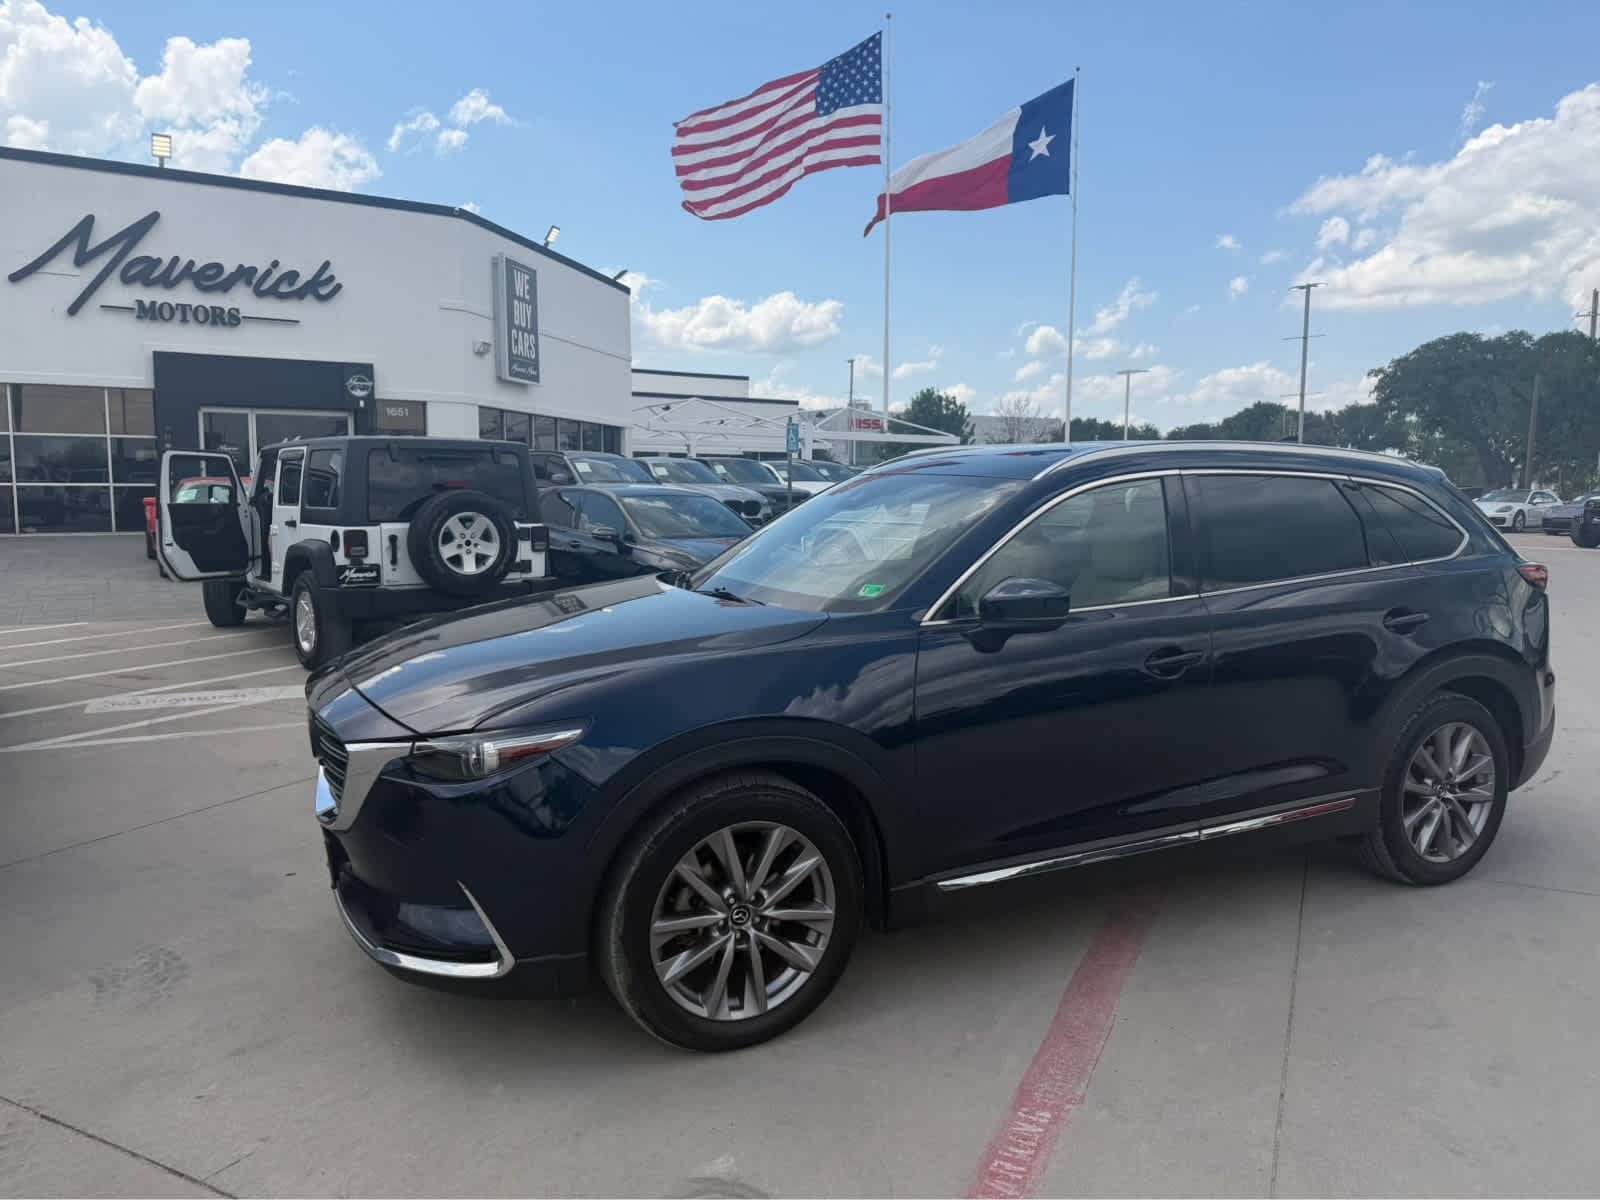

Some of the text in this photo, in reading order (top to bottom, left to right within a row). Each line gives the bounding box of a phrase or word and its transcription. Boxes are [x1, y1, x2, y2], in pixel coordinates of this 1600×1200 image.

[8, 211, 343, 316] Maverick
[513, 269, 530, 300] WE
[135, 299, 242, 327] MOTORS
[513, 299, 532, 329] BUY
[511, 328, 536, 360] CARS
[385, 407, 409, 417] 1651
